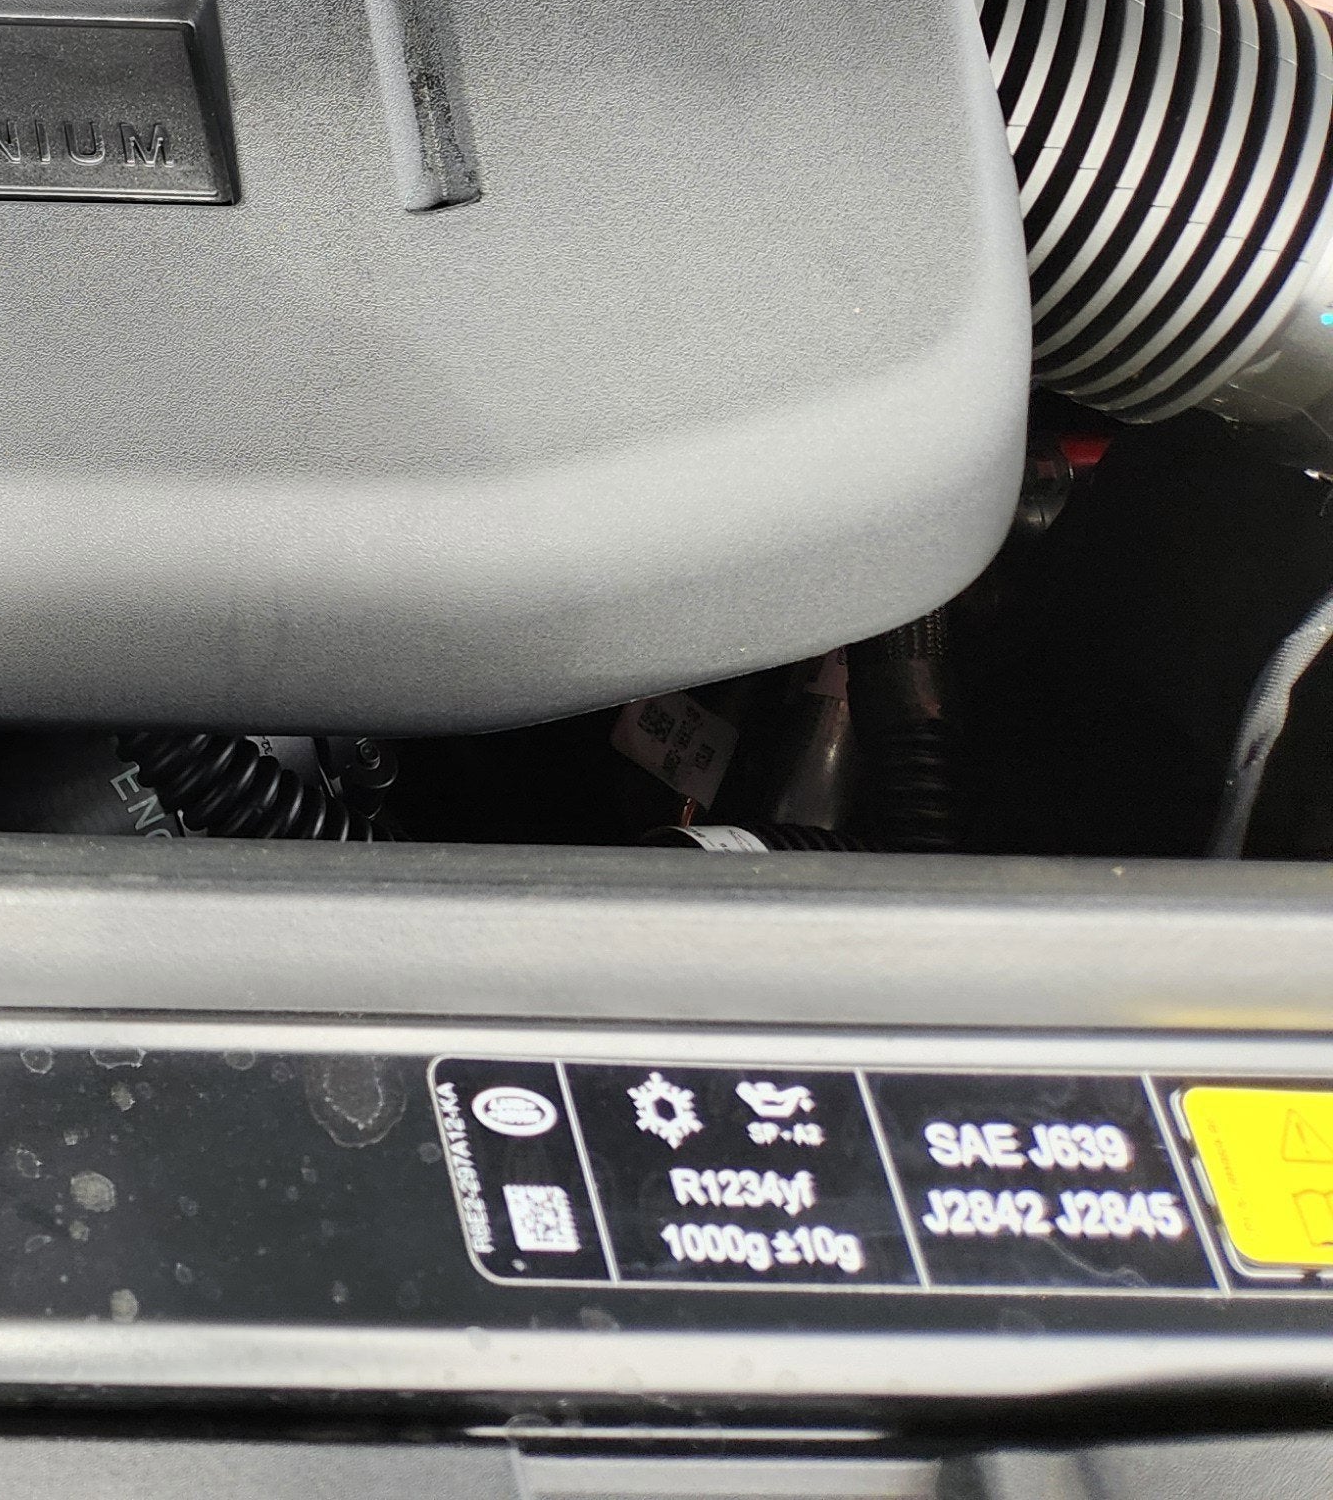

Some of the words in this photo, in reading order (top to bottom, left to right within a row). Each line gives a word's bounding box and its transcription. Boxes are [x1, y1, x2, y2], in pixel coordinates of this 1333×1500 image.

[924, 1121, 1028, 1169] SAE
[1028, 1123, 1134, 1173] J639
[669, 1167, 817, 1217] R1234yf
[922, 1188, 1054, 1237] J2842
[1055, 1189, 1187, 1241] J2845
[660, 1223, 773, 1272] 1000g
[771, 1225, 866, 1274] ±10g
